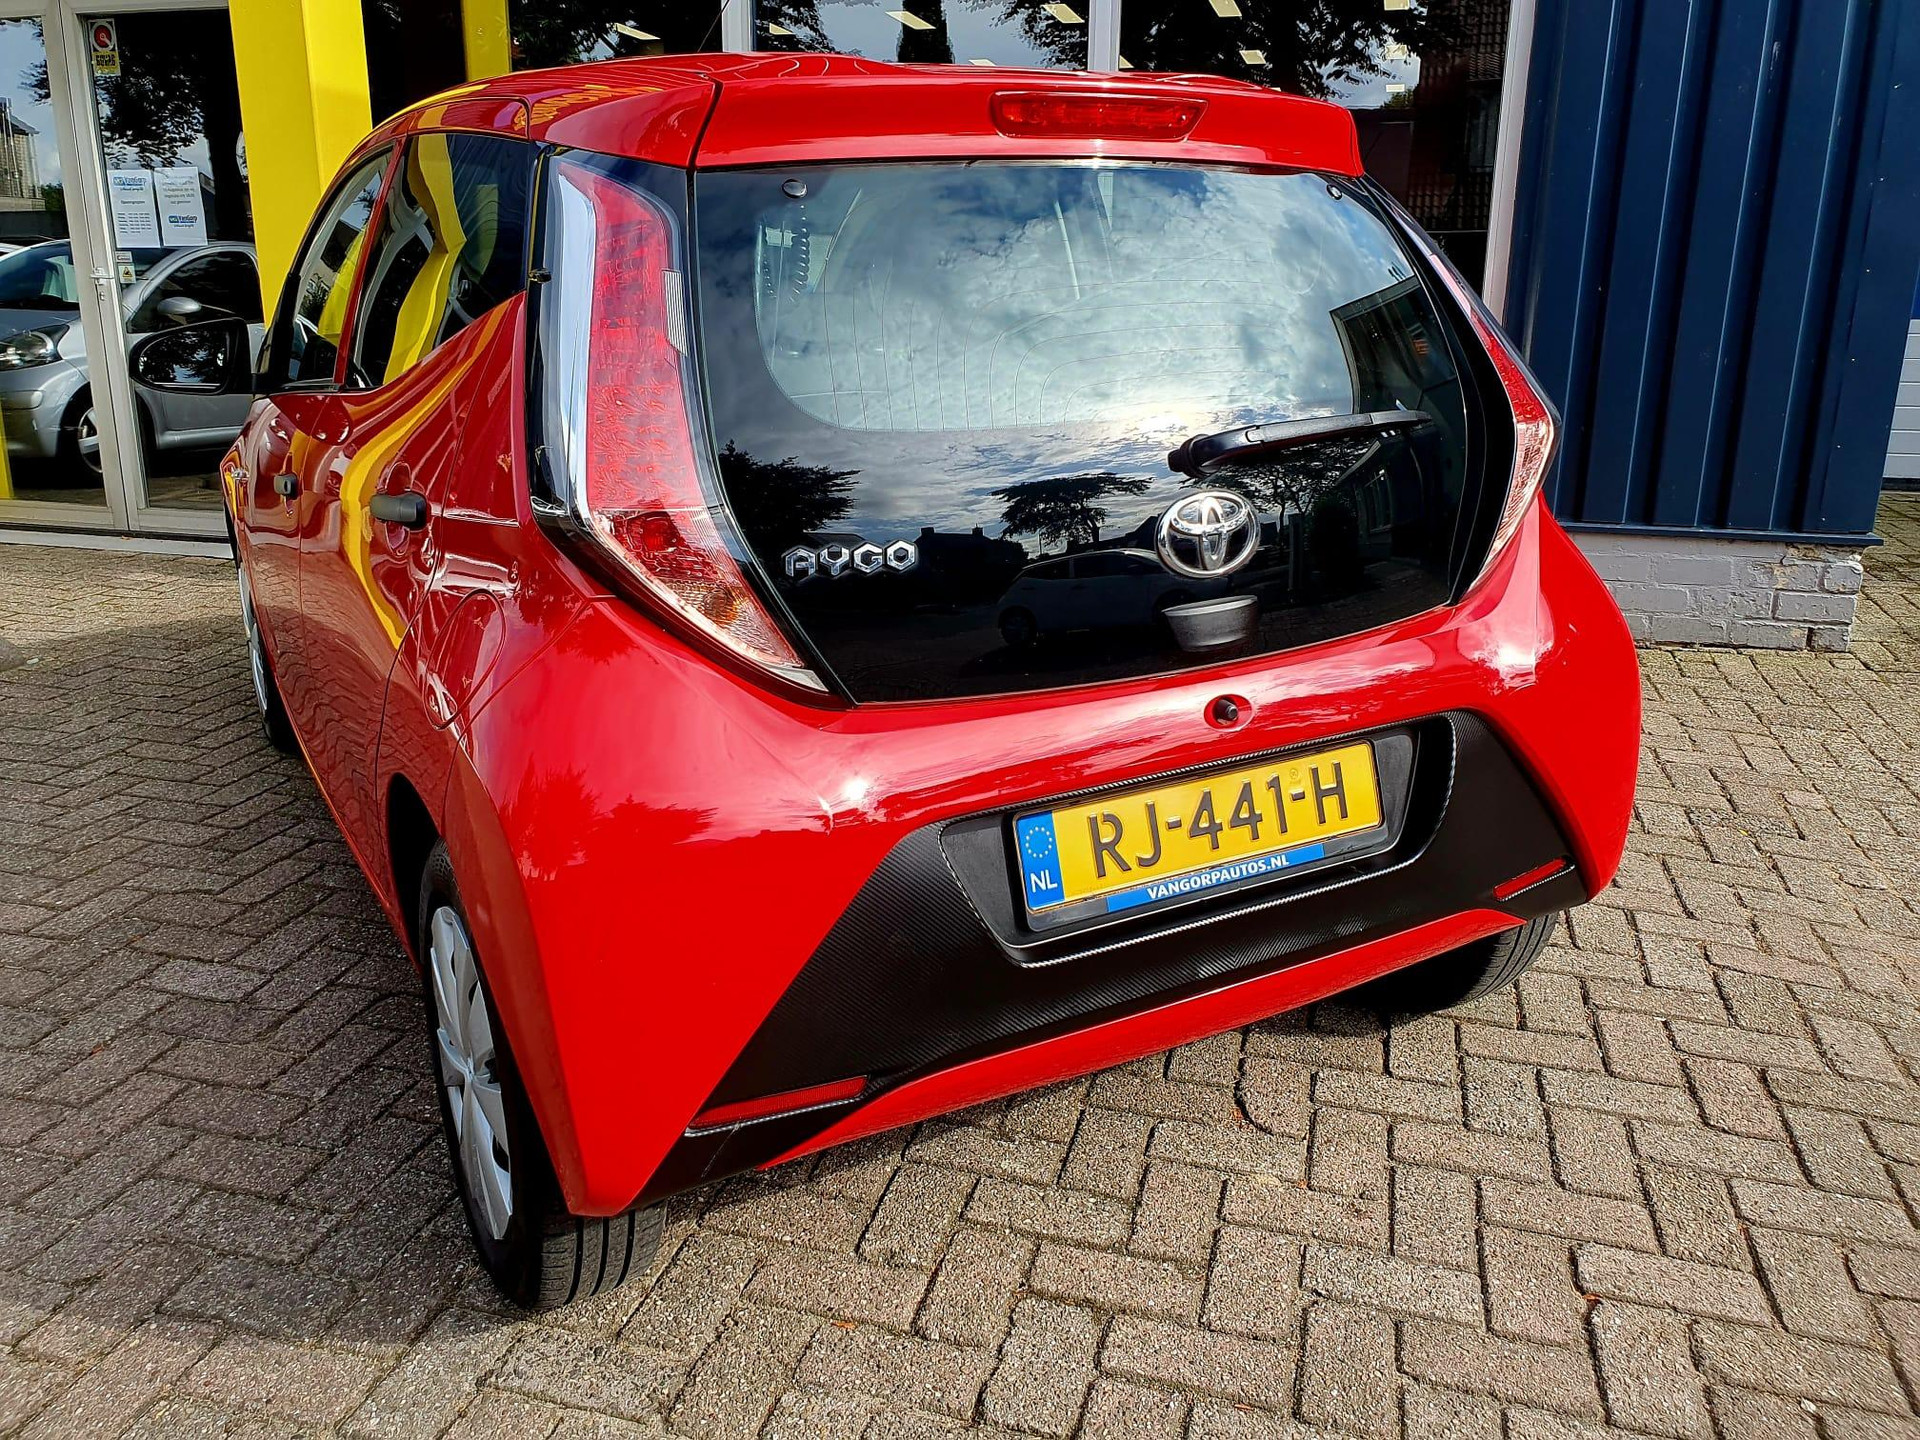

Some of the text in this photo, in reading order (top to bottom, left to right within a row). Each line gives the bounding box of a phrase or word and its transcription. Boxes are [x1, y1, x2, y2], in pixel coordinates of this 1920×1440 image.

[784, 539, 917, 577] AYGO
[1086, 760, 1349, 879] RJ-441-H
[1030, 871, 1058, 894] NL
[1146, 854, 1291, 900] VANGORPAUTOS.NL
